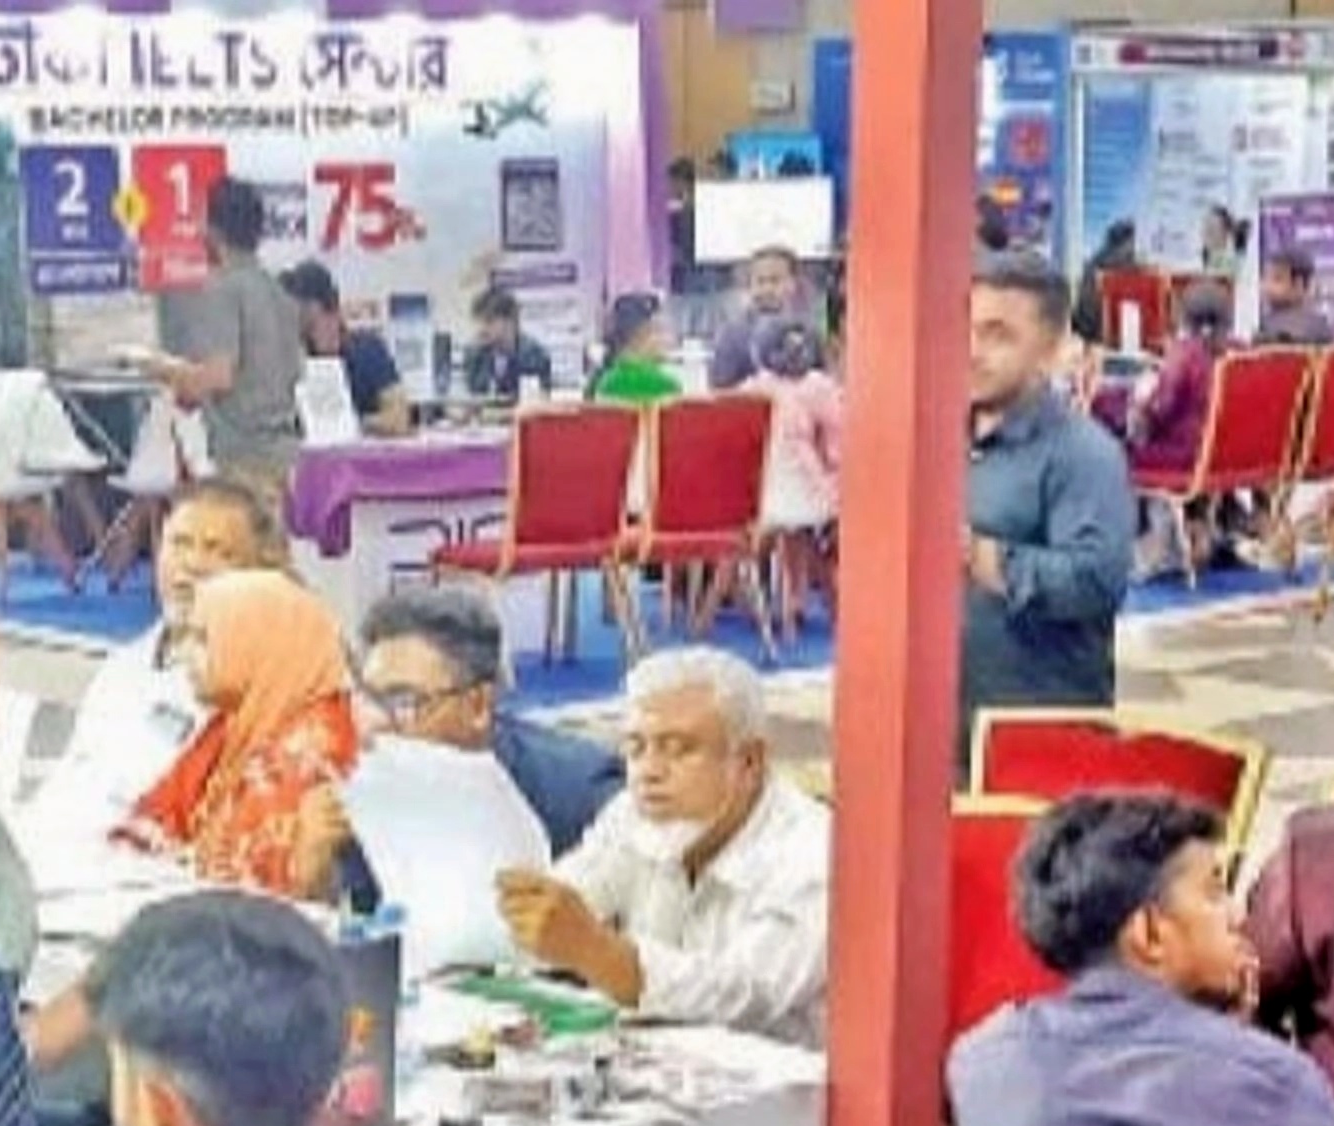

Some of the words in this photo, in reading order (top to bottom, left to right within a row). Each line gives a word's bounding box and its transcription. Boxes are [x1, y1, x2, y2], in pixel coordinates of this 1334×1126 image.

[130, 30, 279, 90] IELTS
[30, 105, 164, 132] BACHELOR
[170, 105, 296, 131] PROGRAM
[54, 161, 89, 216] 2
[168, 162, 191, 216] 1
